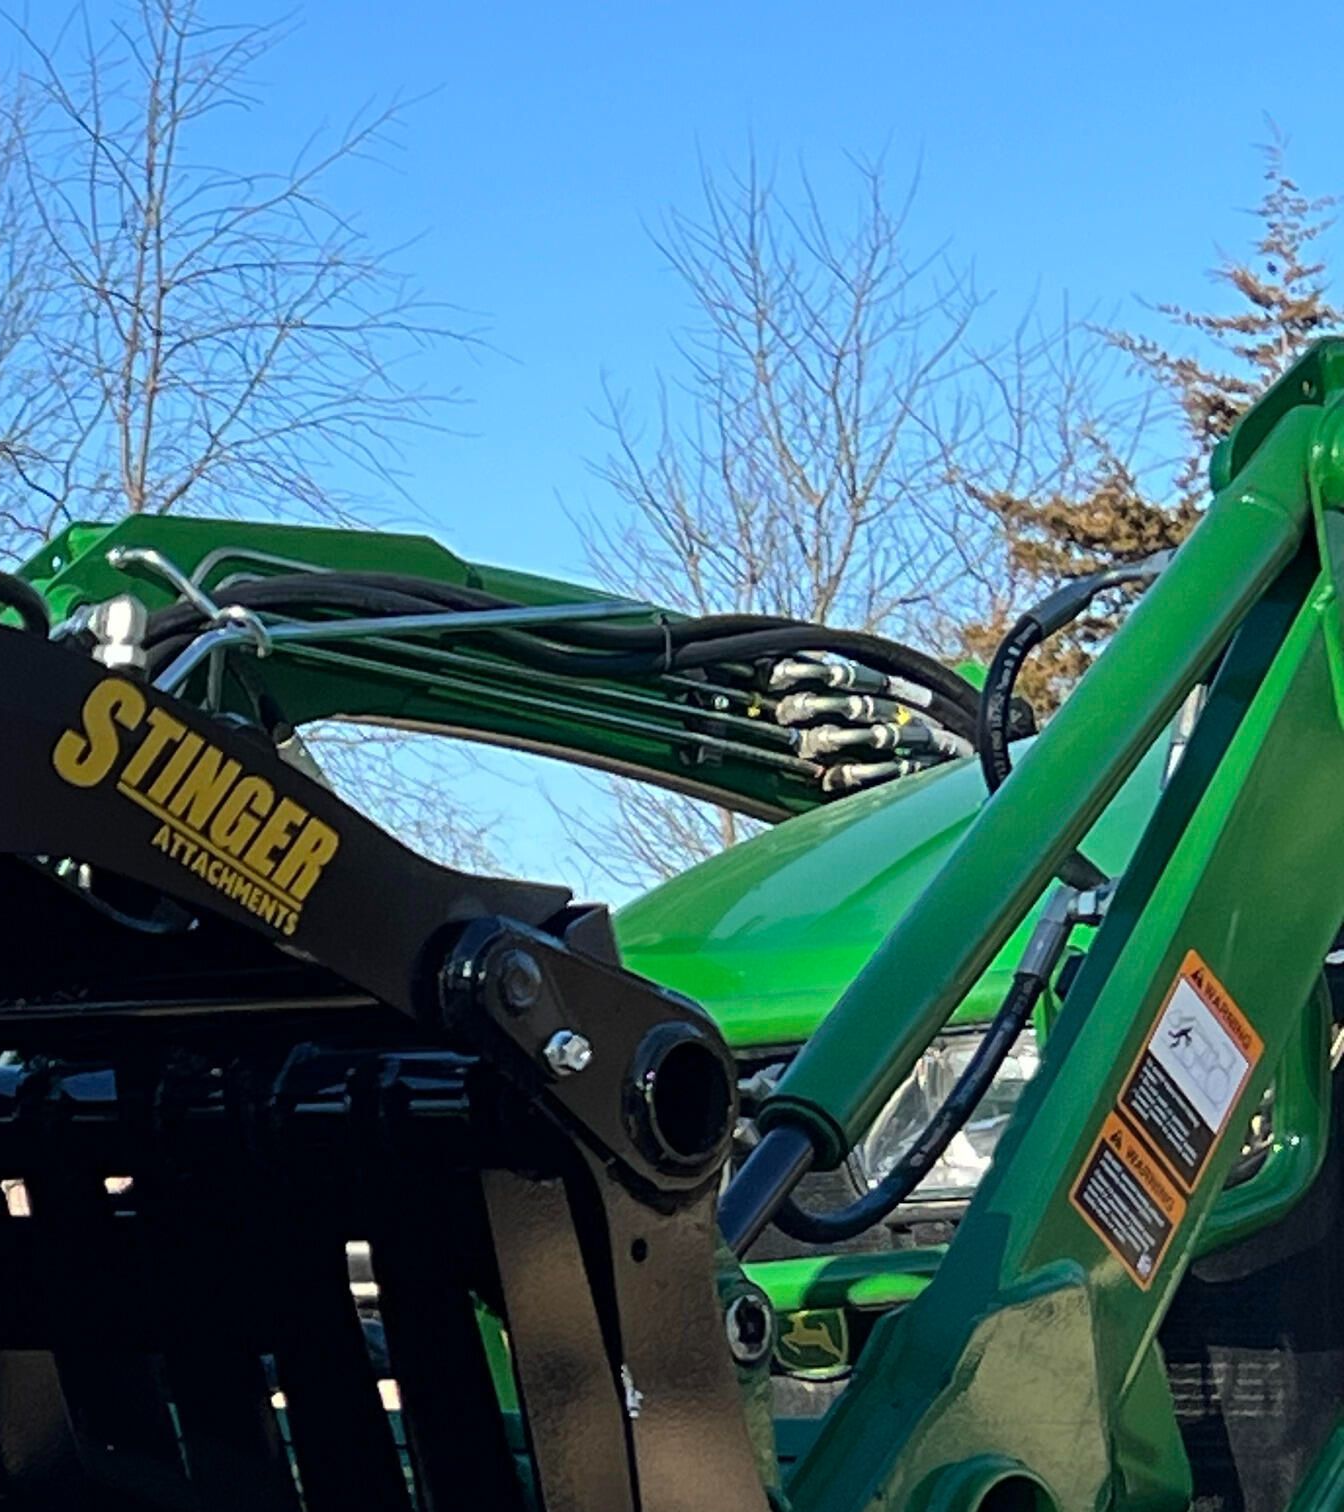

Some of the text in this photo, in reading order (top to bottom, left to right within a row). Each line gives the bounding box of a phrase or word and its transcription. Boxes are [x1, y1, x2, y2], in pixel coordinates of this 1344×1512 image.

[53, 677, 340, 902] STINGER
[152, 826, 300, 936] ATTACHMENTS
[1203, 982, 1252, 1050] WARNING
[1124, 1148, 1176, 1213] WARNING
